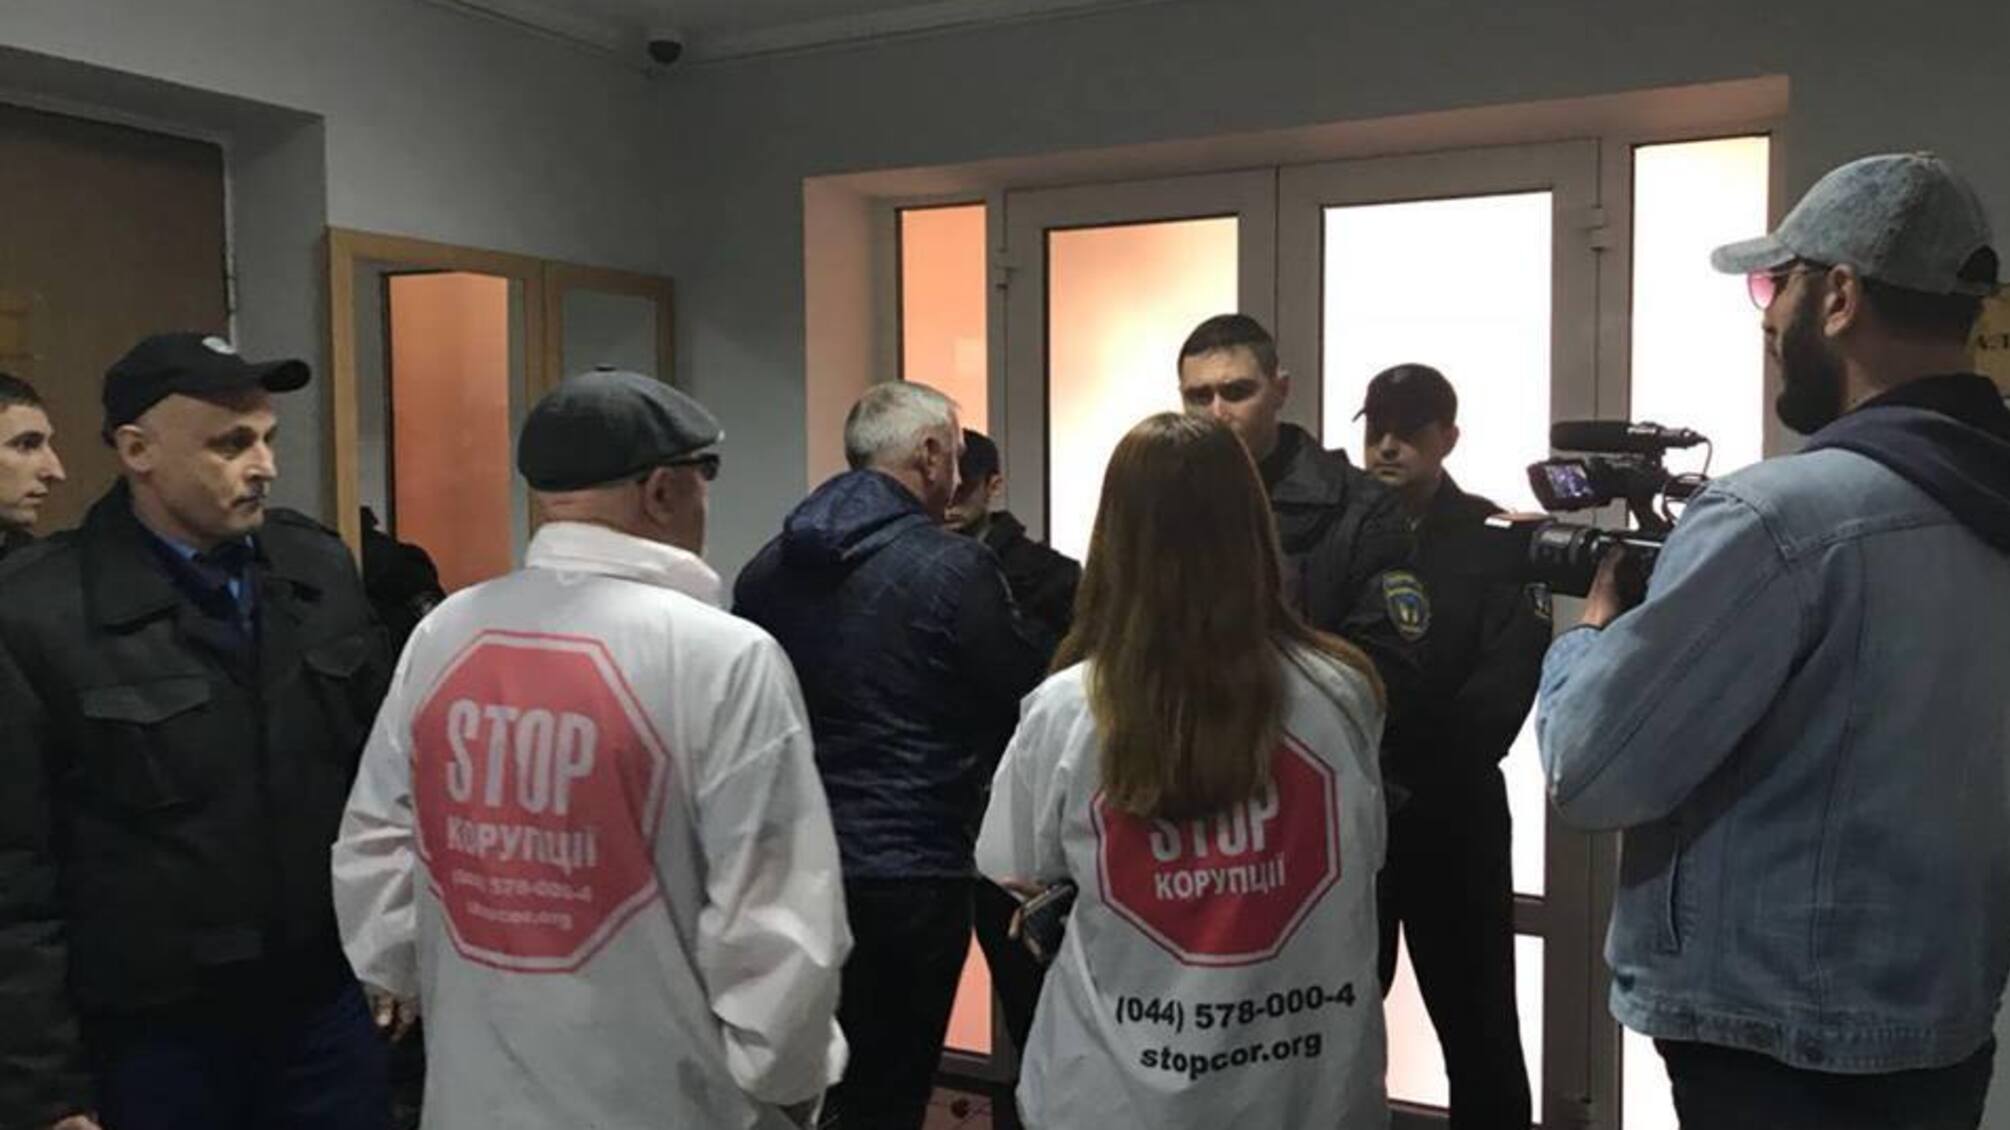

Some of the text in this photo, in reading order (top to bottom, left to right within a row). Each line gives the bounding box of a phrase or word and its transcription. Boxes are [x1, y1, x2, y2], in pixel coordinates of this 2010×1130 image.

[447, 698, 598, 816] STOP
[446, 815, 598, 876] КОРУПЦІЇ
[1155, 854, 1286, 901] КОРУПЦІЇ
[1115, 982, 1356, 1033] (044) 578-000-4
[1140, 1032, 1323, 1080] stopcor.org
